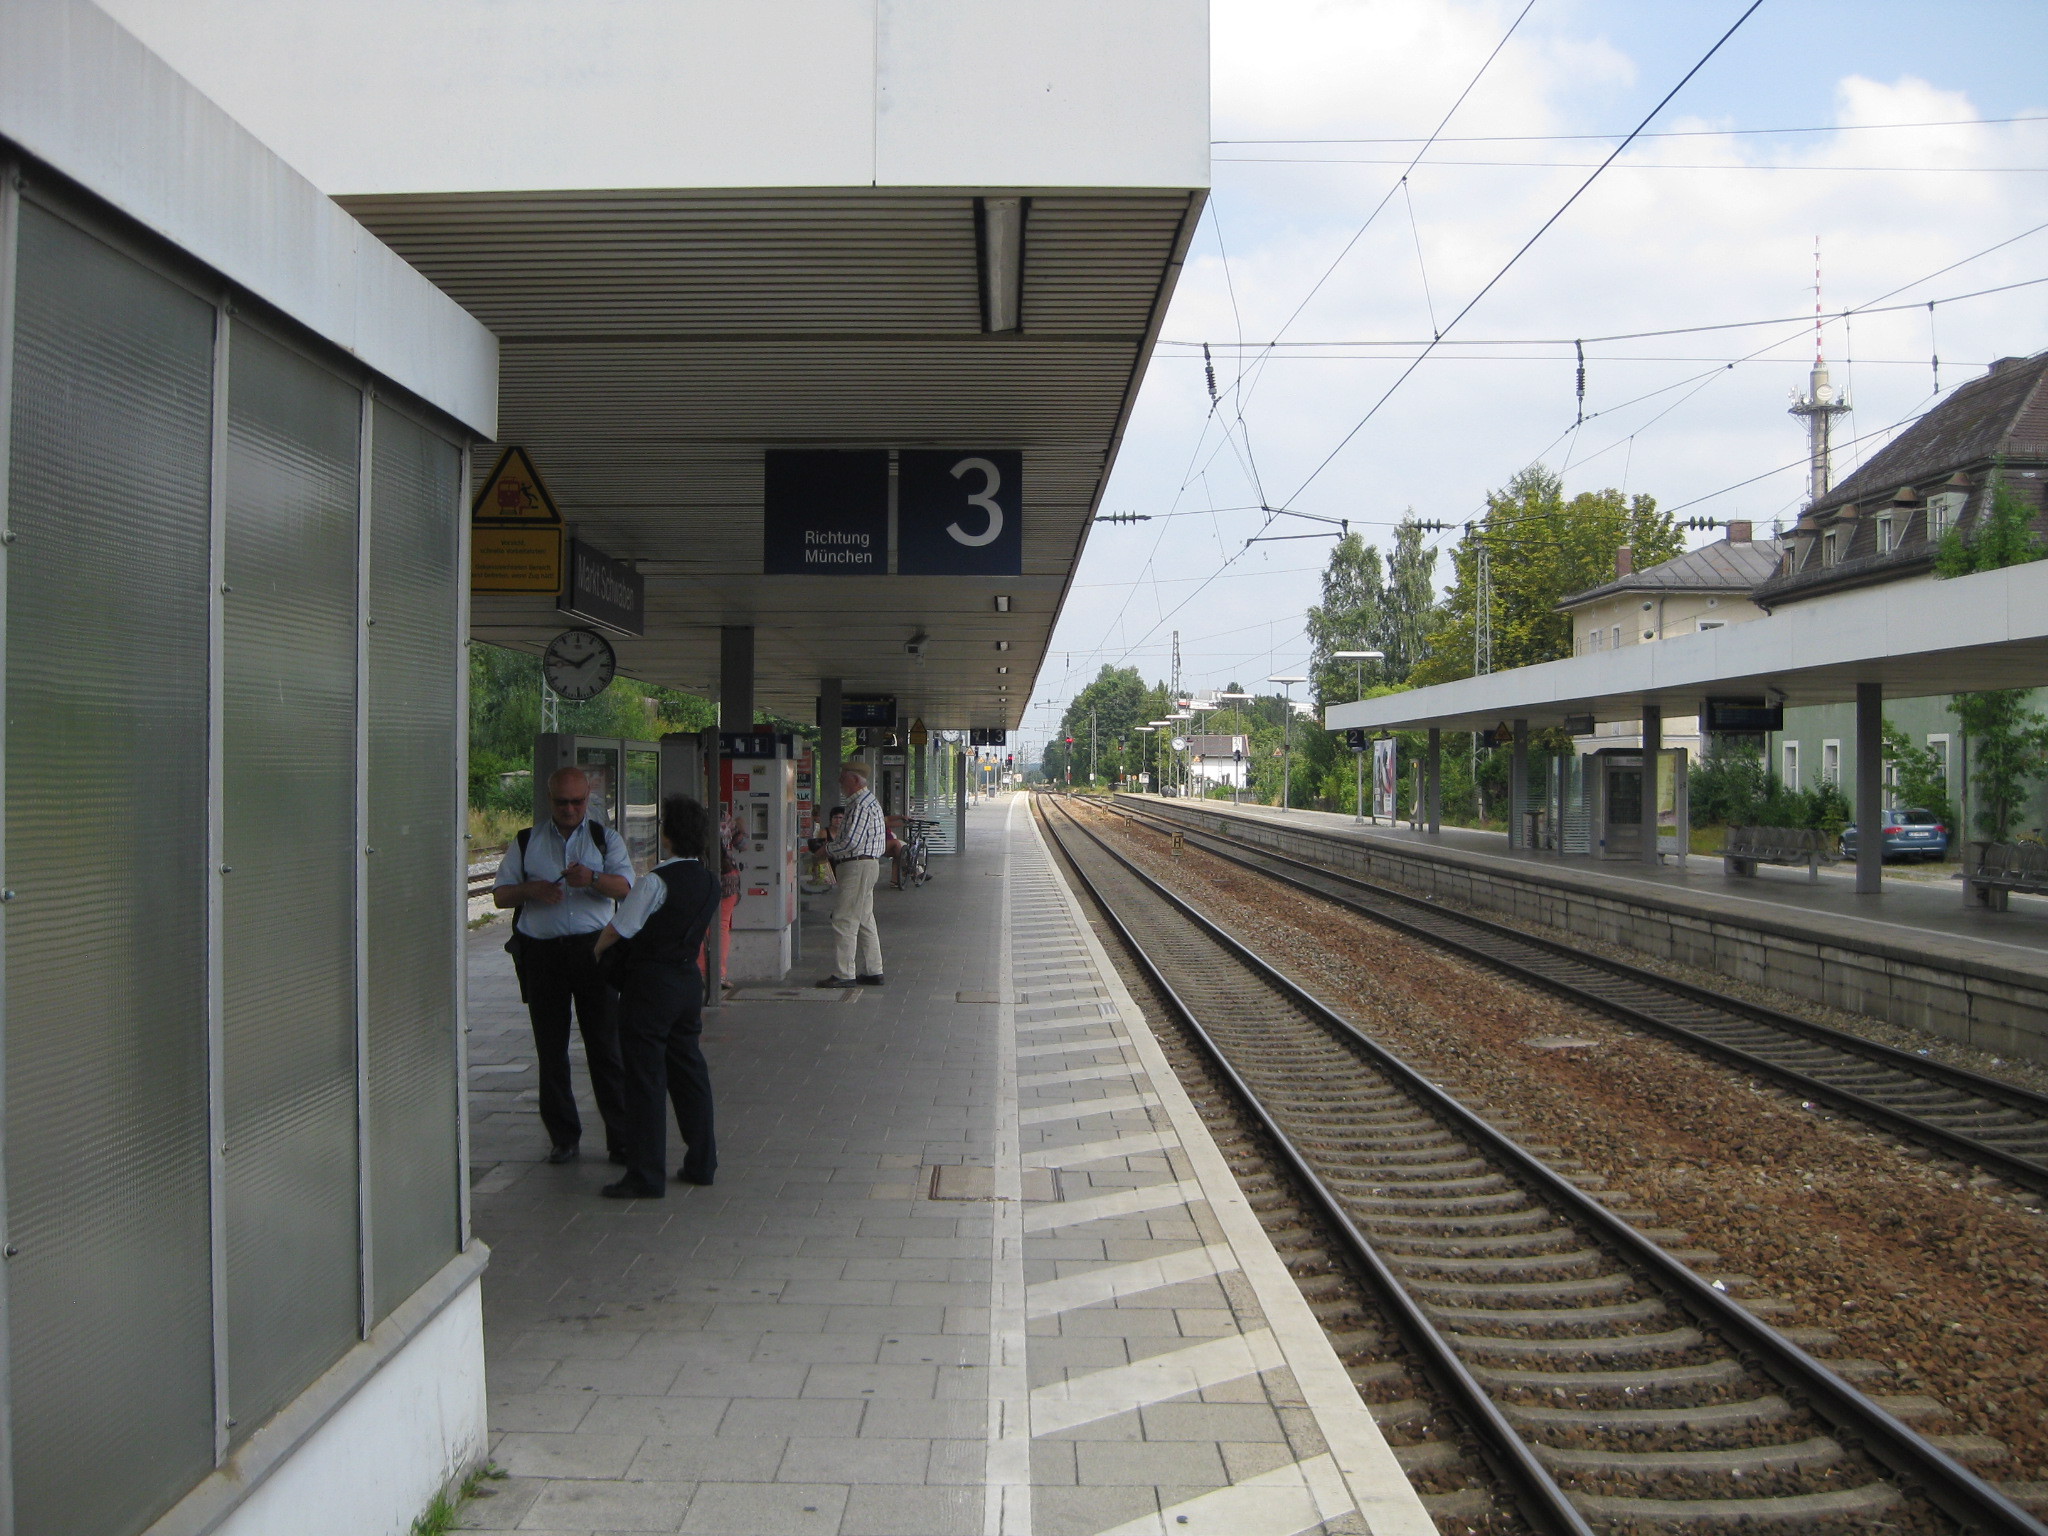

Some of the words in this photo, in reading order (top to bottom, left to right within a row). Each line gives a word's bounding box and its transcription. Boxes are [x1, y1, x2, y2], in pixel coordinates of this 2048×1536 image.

[945, 457, 1004, 547] 3
[805, 530, 870, 548] Richtung
[805, 549, 873, 563] München
[577, 553, 600, 597] Markt
[600, 565, 634, 611] Schwaben
[858, 728, 867, 742] 4
[994, 729, 1004, 743] 3
[1349, 730, 1358, 744] 2
[1173, 837, 1181, 848] H
